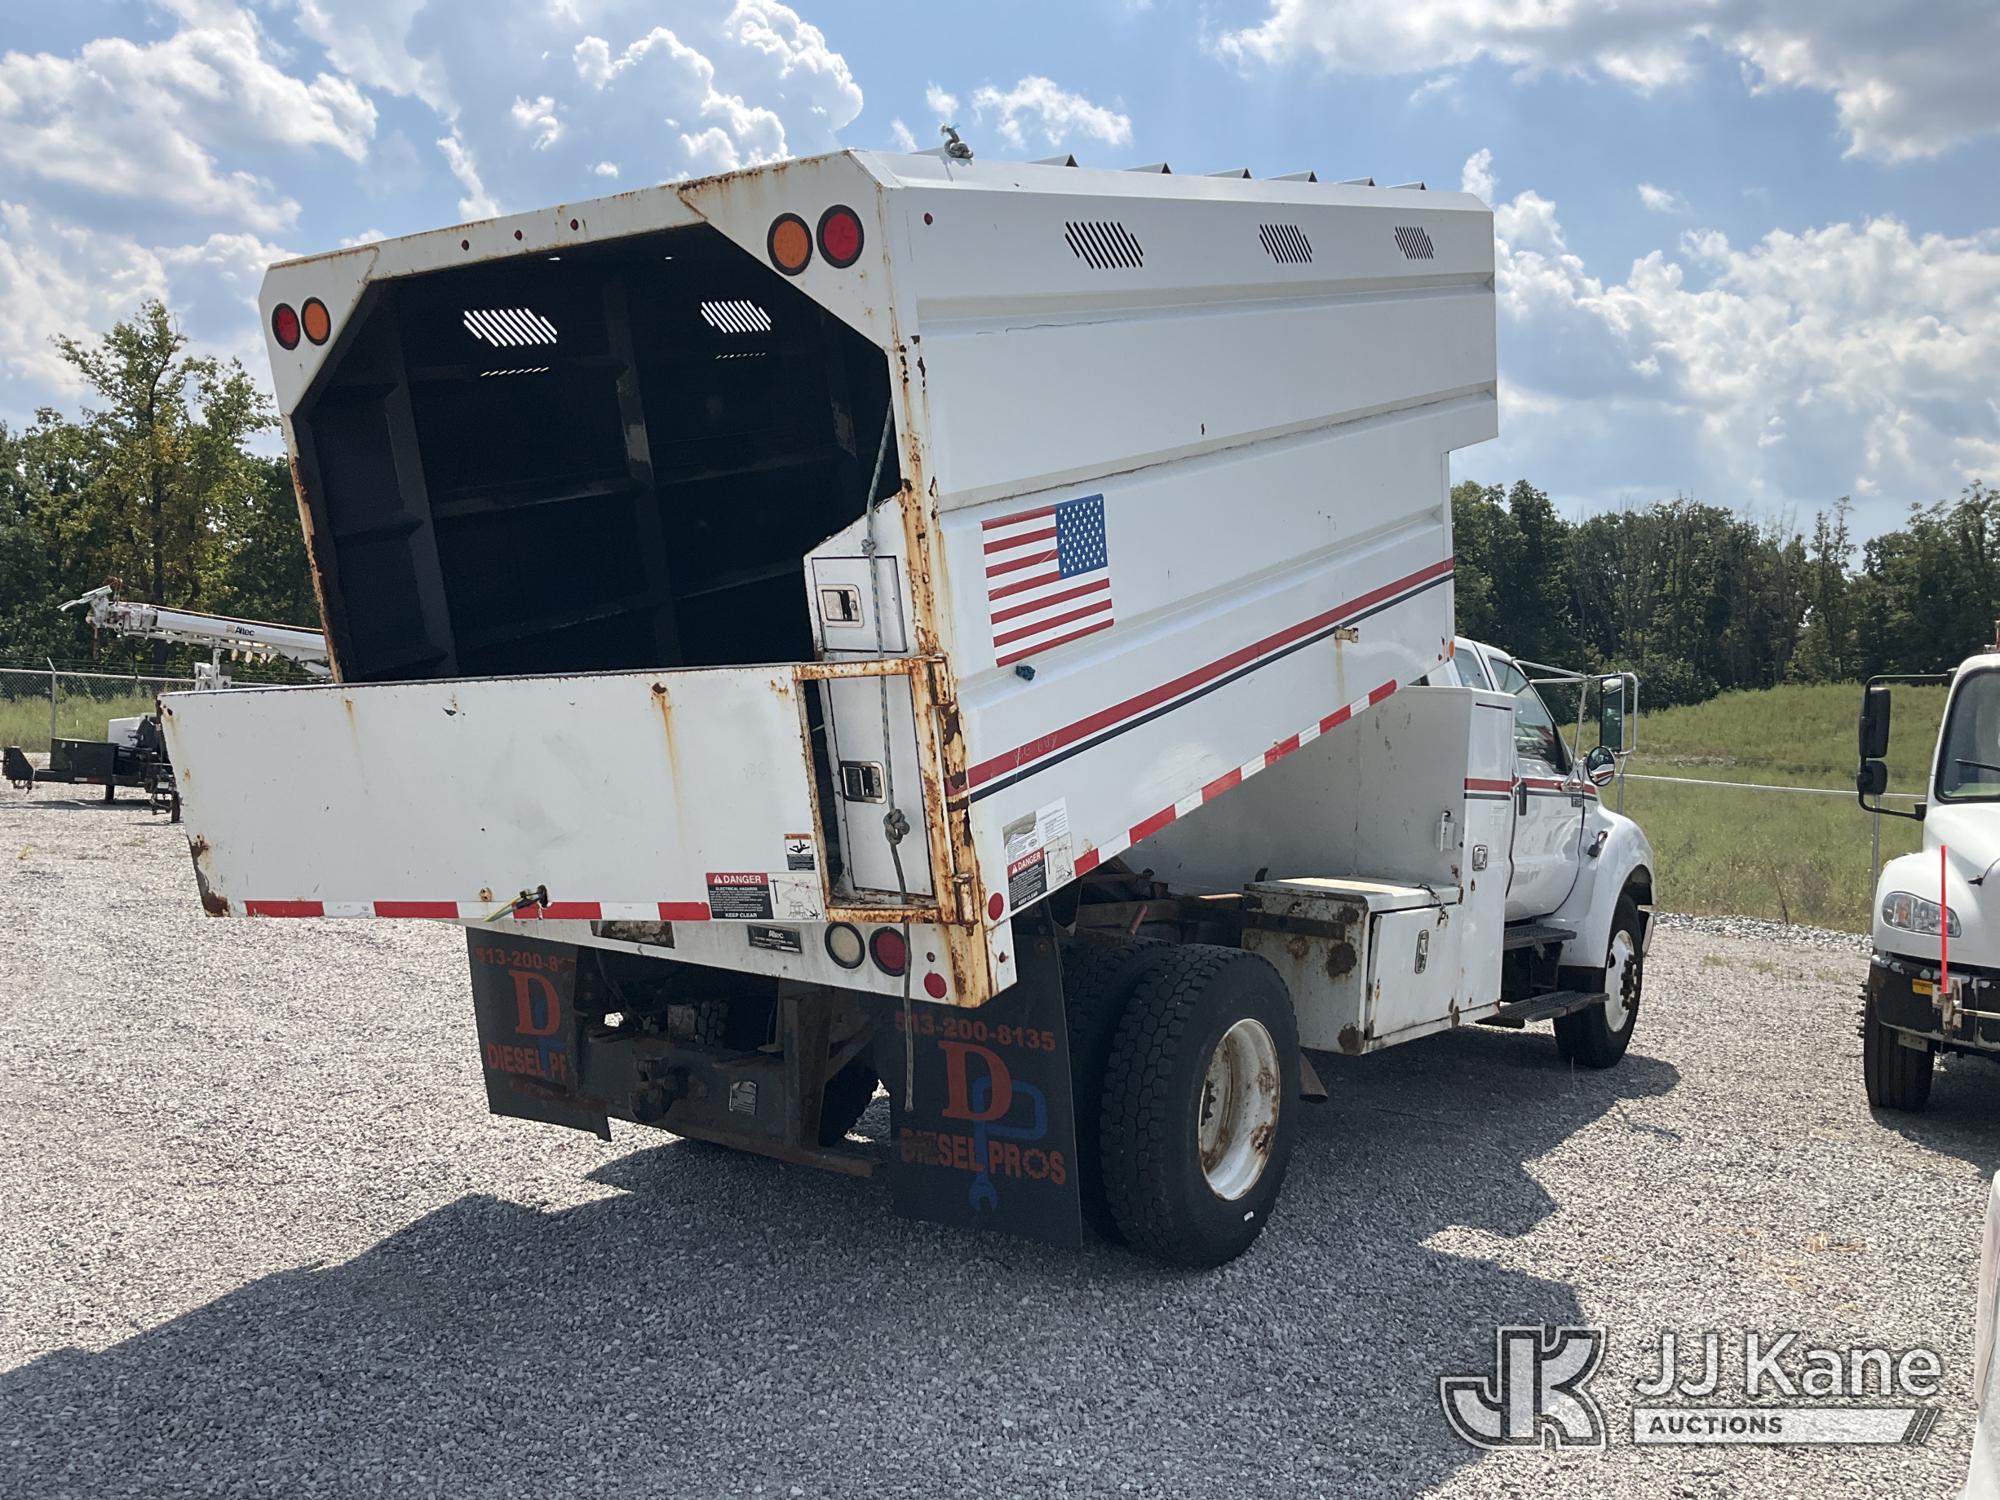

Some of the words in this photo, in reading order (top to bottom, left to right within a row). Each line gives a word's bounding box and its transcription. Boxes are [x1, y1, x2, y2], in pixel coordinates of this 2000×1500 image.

[235, 626, 255, 636] Altec
[1017, 851, 1041, 870] DANGER
[723, 875, 762, 884] DANGER
[508, 969, 560, 1036] D
[488, 1042, 545, 1076] DIESEL
[901, 1128, 983, 1171] DIESEL
[988, 1141, 1066, 1184] PROS
